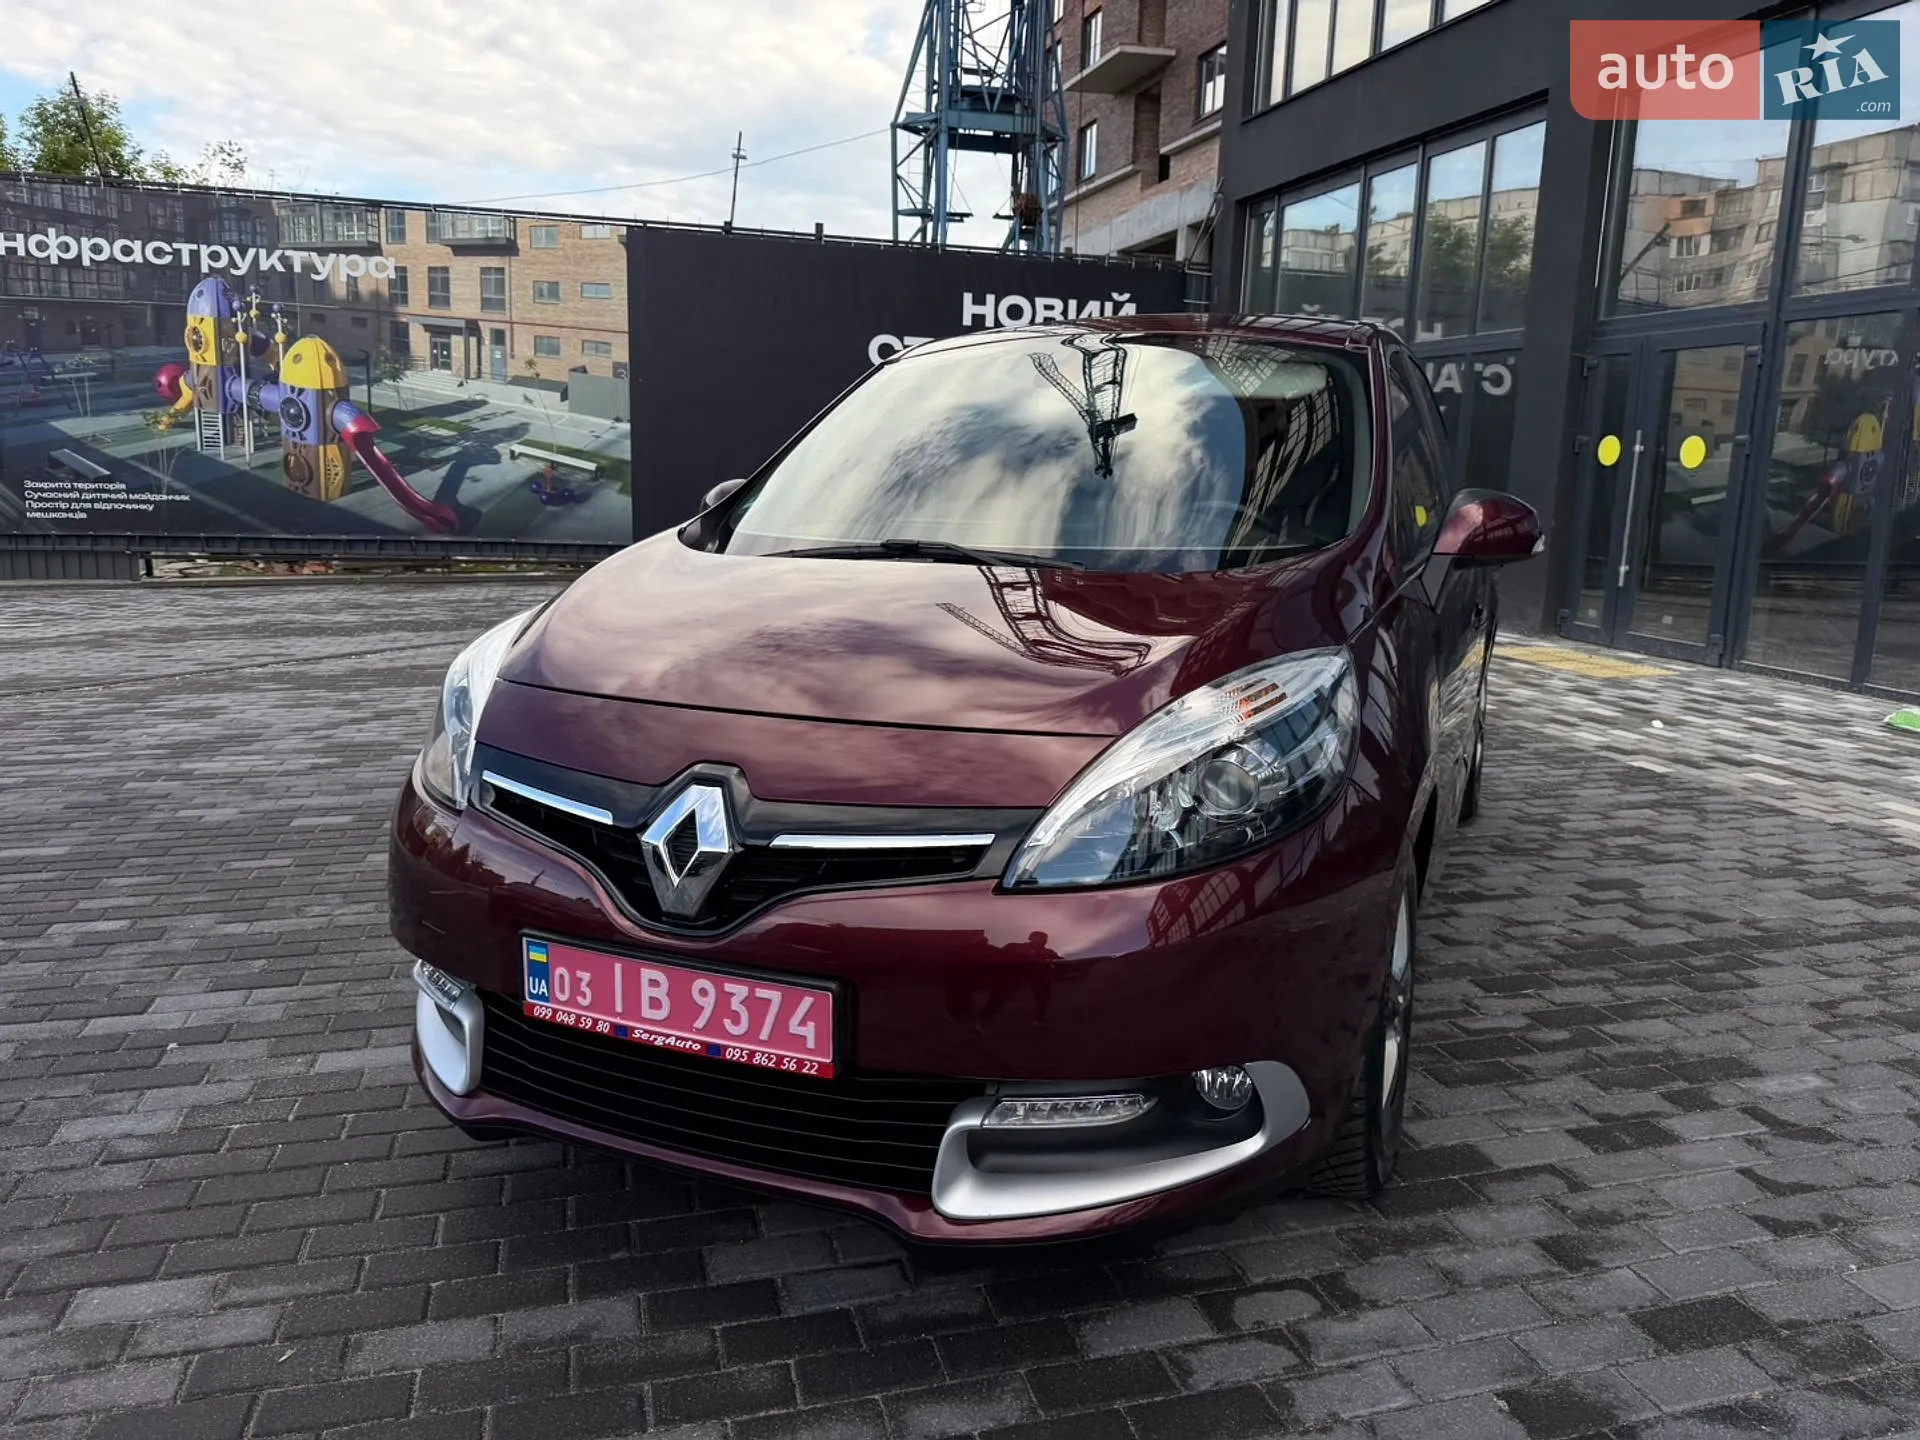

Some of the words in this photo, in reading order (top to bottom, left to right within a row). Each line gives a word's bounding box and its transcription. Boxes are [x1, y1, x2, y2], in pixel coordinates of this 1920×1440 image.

[0, 227, 396, 282] нфраструктура
[962, 291, 1138, 328] НОВИЙ
[23, 480, 71, 489] Закрита
[72, 481, 127, 490] територія
[24, 489, 80, 499] Сучасний
[81, 491, 128, 500] дитячий
[129, 492, 191, 501] майданчик
[25, 500, 70, 509] Простір
[93, 501, 155, 511] відпочинку
[26, 510, 88, 519] мешканців
[528, 976, 549, 996] UA
[554, 966, 593, 1007] 03
[691, 978, 816, 1050] 9374
[533, 1003, 553, 1019] 099
[555, 1010, 576, 1026] 048
[578, 1016, 593, 1029] 59
[595, 1020, 611, 1034] 80
[631, 1028, 702, 1051] SergAuto
[725, 1047, 750, 1062] 095
[753, 1052, 777, 1068] 862
[780, 1057, 798, 1071] 56
[801, 1061, 820, 1075] 22
